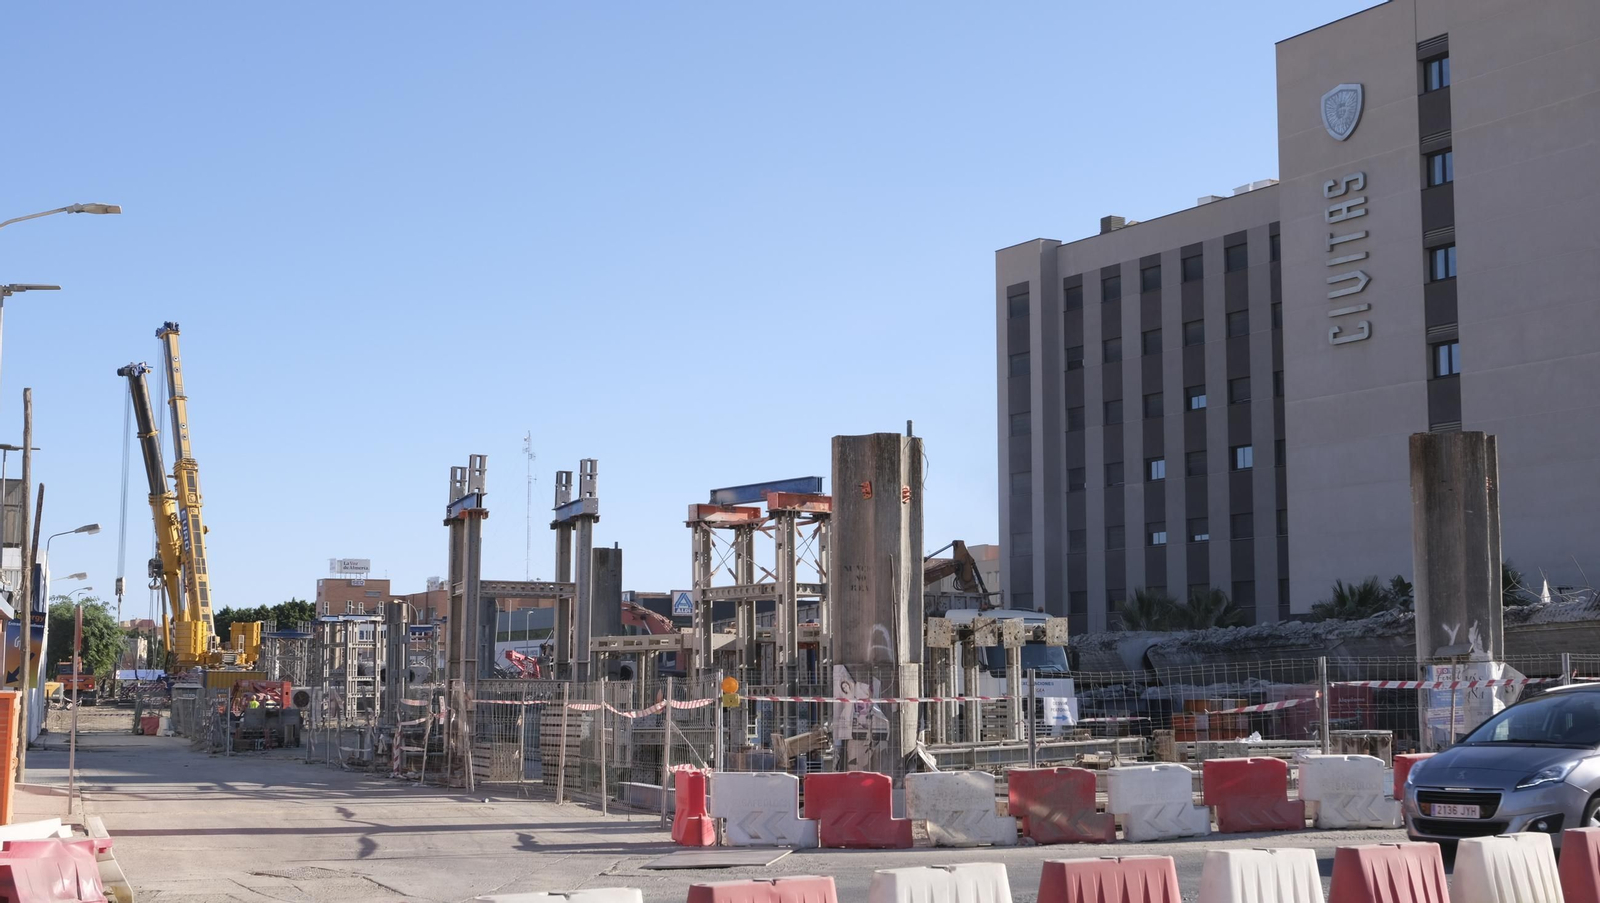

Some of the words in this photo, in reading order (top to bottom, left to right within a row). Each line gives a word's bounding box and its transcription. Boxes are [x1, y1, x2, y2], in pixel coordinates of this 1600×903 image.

[1323, 171, 1372, 345] CIVITAS
[1437, 806, 1458, 815] 2136
[1460, 806, 1476, 816] JYH
